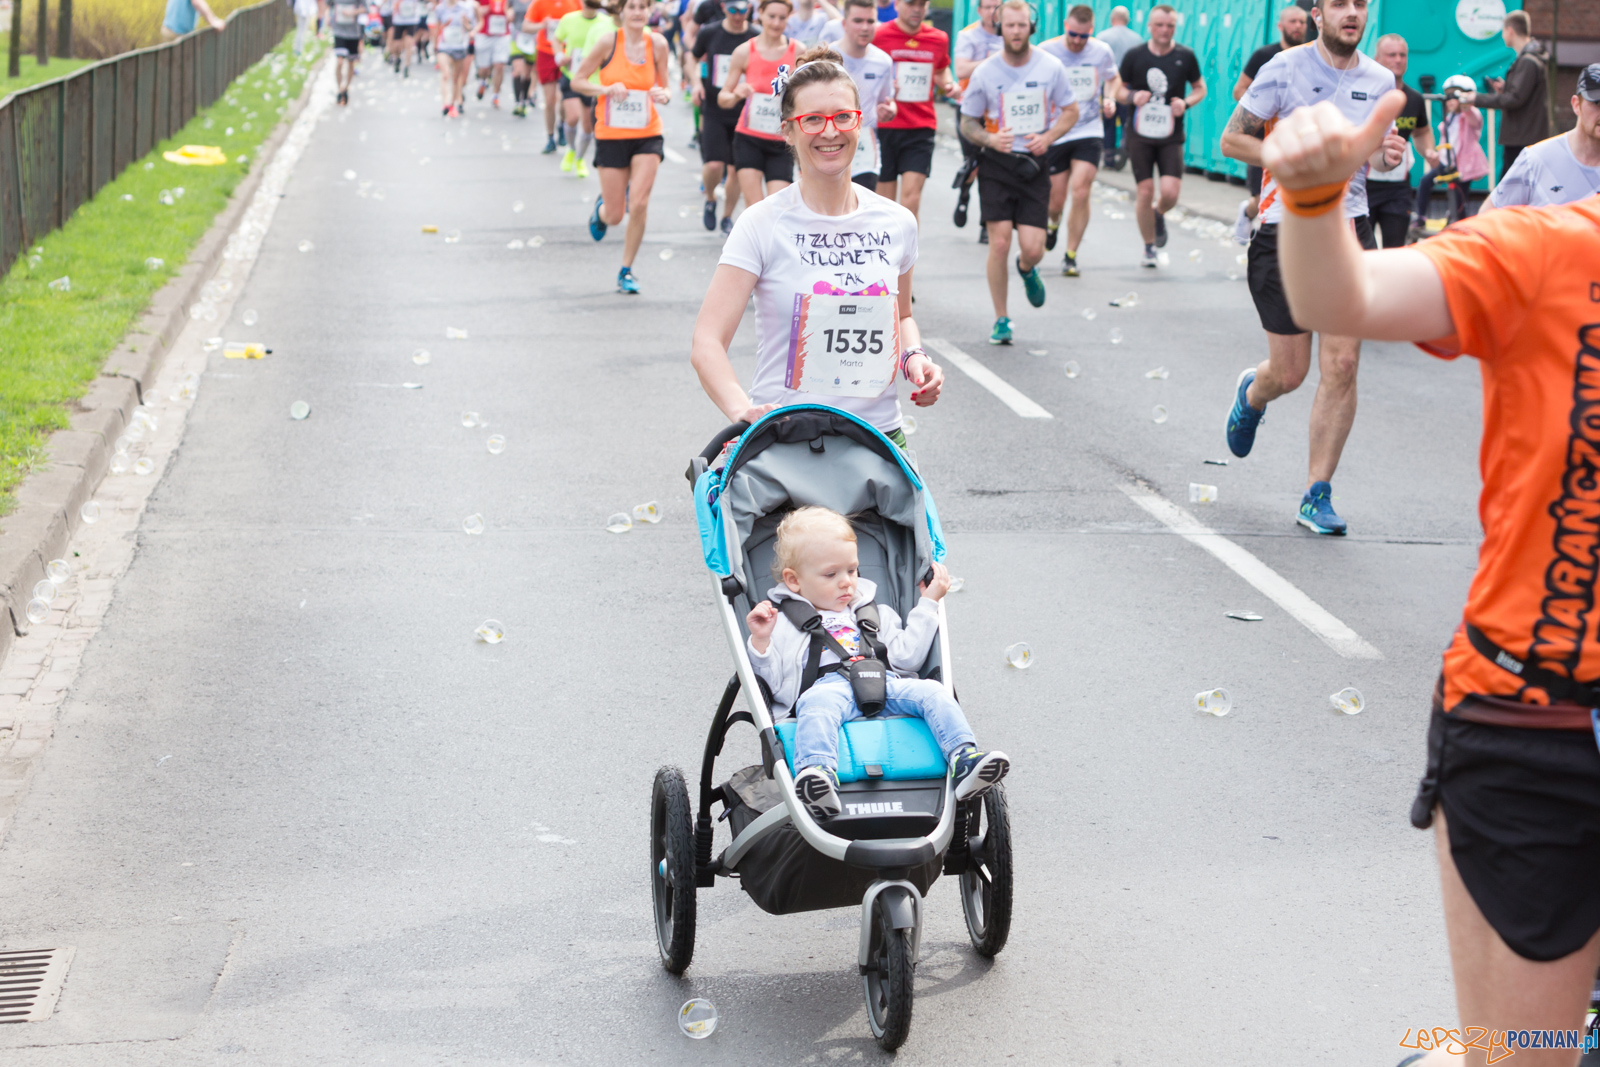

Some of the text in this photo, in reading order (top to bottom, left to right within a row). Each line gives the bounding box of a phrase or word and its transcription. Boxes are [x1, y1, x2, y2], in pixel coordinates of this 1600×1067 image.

[904, 74, 928, 85] 7975
[1011, 103, 1040, 116] 5587
[799, 248, 890, 266] KILOMETR
[834, 272, 864, 286] TAK
[823, 328, 884, 355] 1535
[839, 359, 864, 367] Marta
[845, 801, 904, 816] THULE
